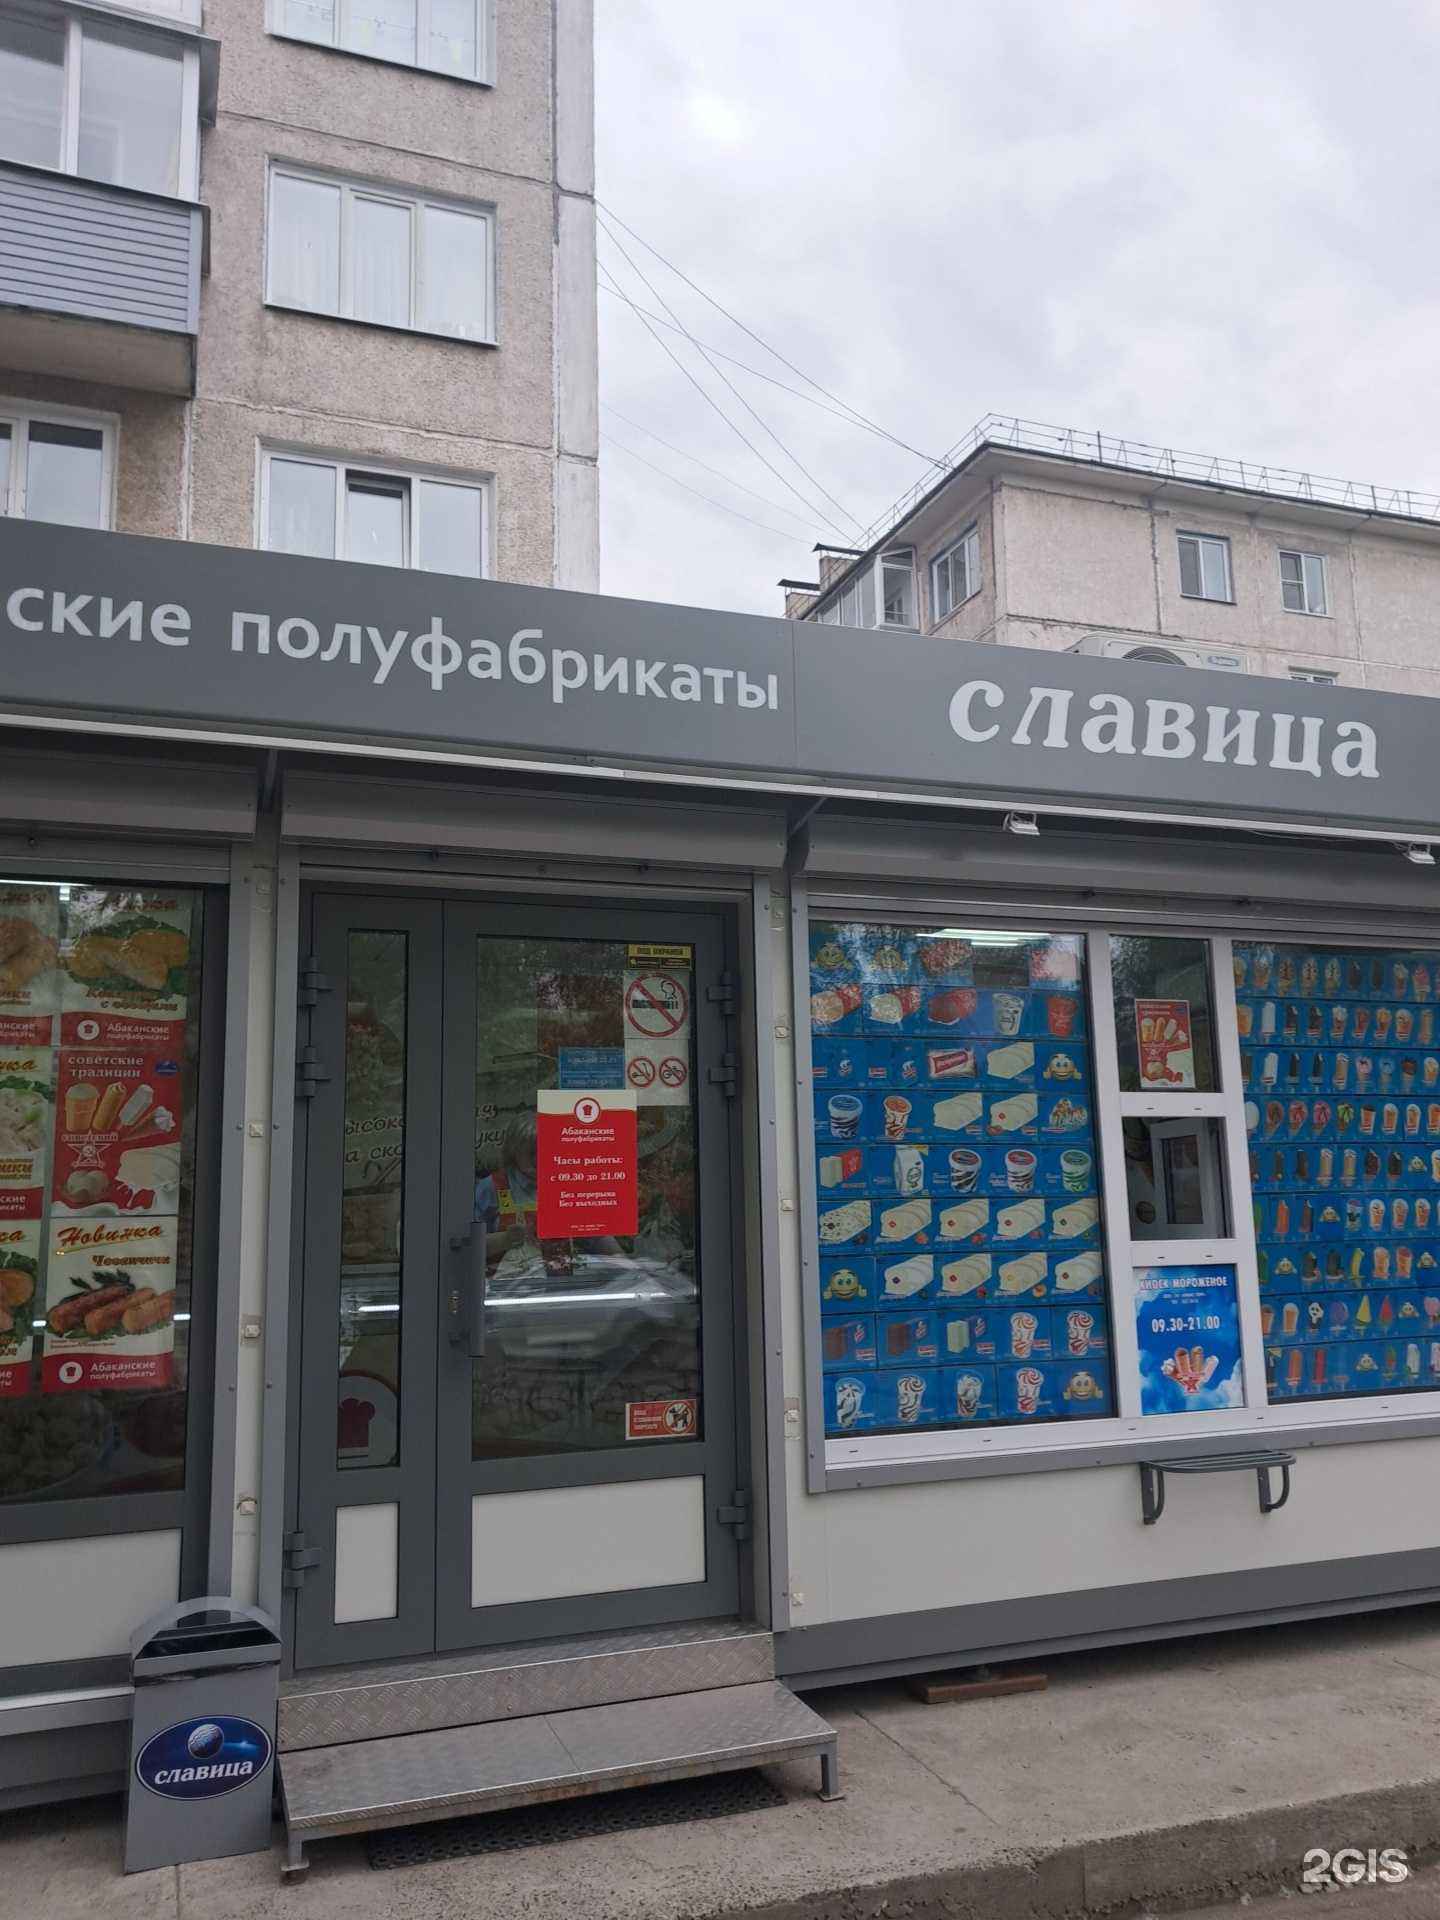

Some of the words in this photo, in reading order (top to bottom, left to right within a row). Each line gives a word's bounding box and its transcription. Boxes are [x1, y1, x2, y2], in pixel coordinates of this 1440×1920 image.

[6, 588, 191, 646] ские
[231, 611, 778, 710] полуфабрикаты
[949, 680, 1380, 778] славица
[107, 1023, 169, 1034] Абаканские
[68, 1056, 144, 1066] советские
[72, 1068, 141, 1079] традиции
[561, 1126, 615, 1136] Абаканские
[554, 1156, 581, 1166] Часы
[584, 1155, 624, 1166] работы:
[558, 1172, 584, 1182] 09.30
[586, 1174, 598, 1182] до
[600, 1171, 626, 1181] 21.00
[560, 1190, 575, 1199] Без
[559, 1199, 574, 1208] Без
[58, 1224, 162, 1247] Новинка
[1172, 1276, 1229, 1288] МОРОЖЕНОЕ
[1151, 1315, 1221, 1333] 09.30-21.00
[90, 1361, 157, 1372] Абаканские
[154, 1760, 254, 1785] славица
